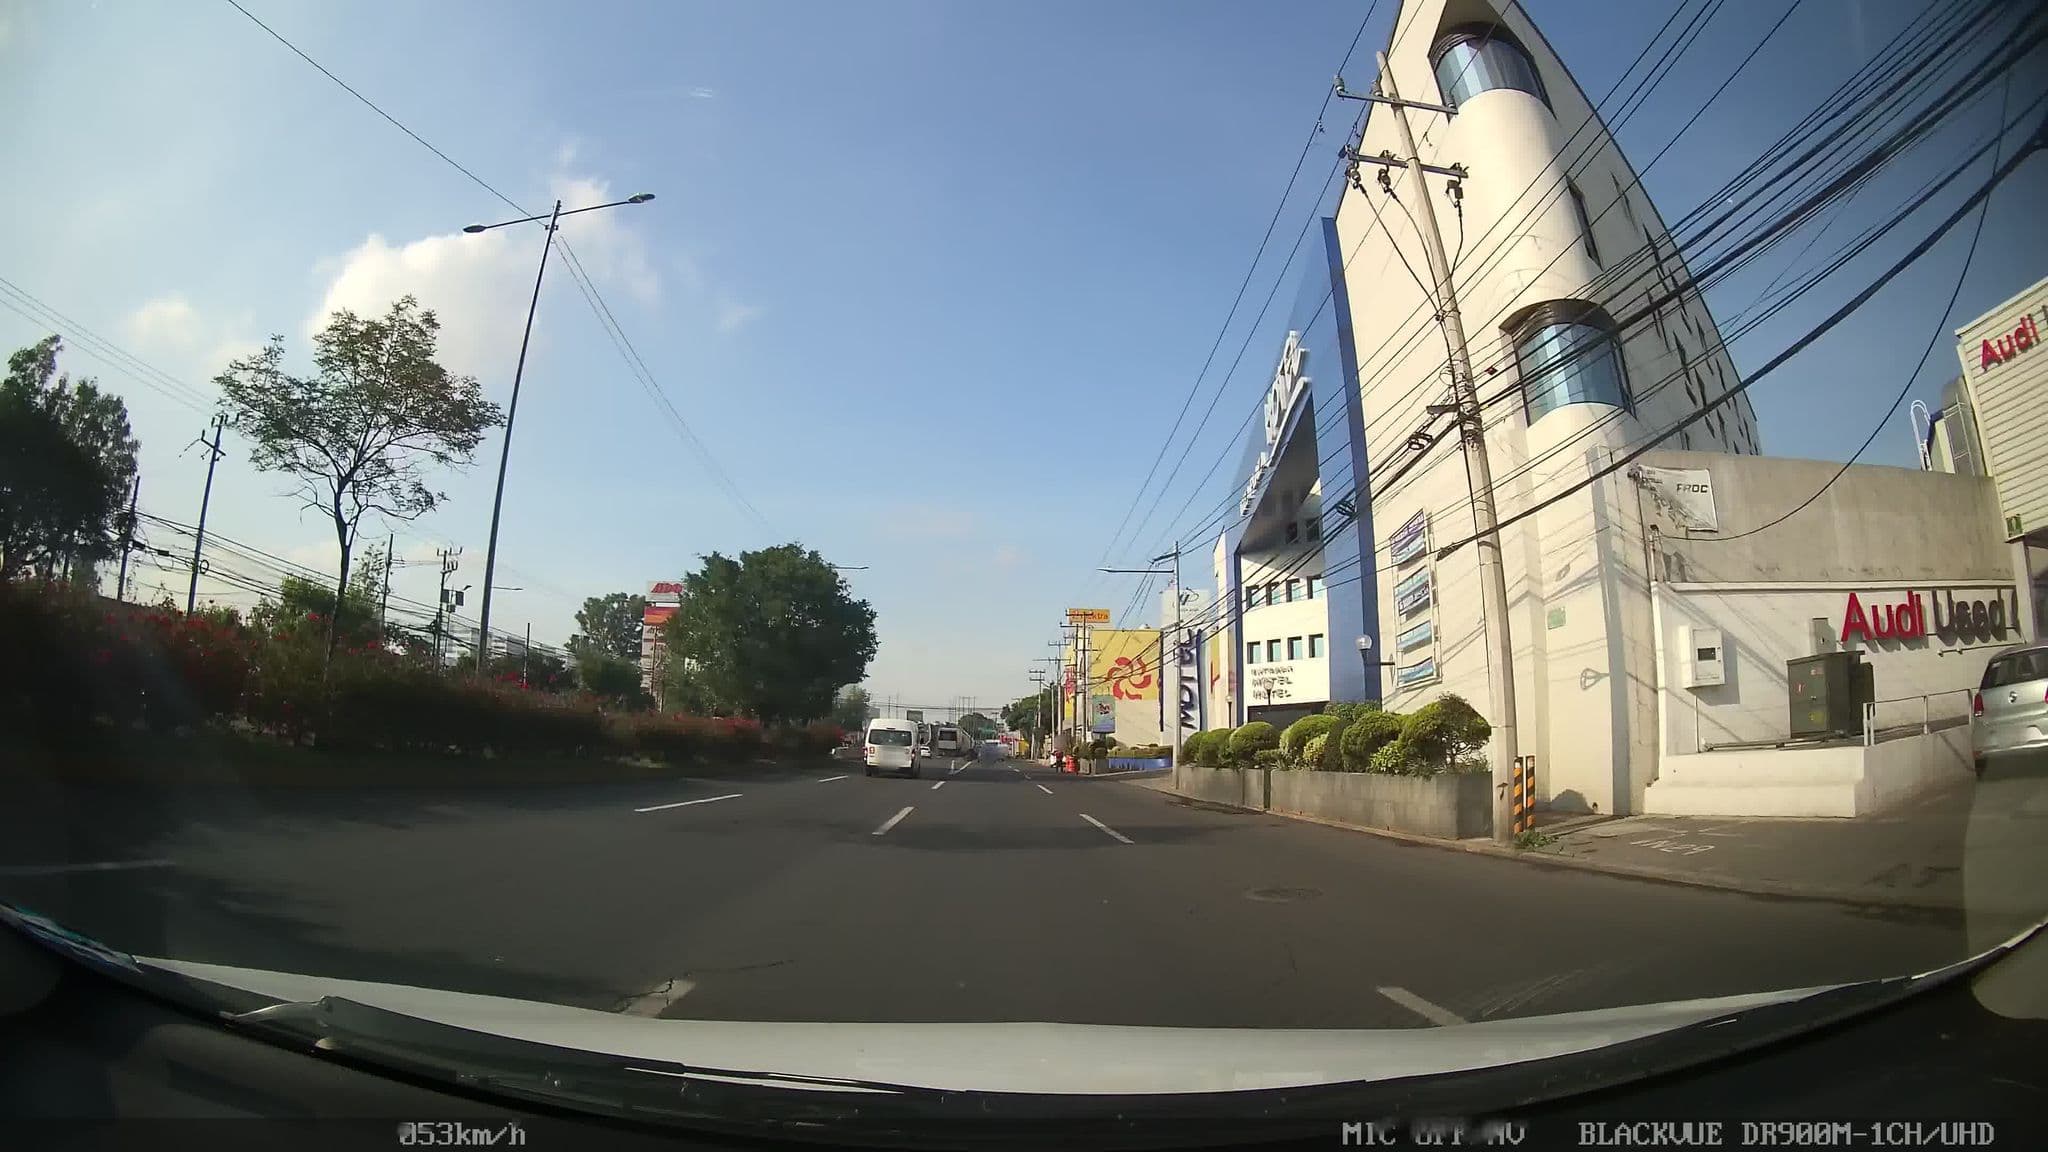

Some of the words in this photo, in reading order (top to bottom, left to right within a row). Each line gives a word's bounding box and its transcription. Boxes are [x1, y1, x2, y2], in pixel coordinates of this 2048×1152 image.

[1980, 313, 2040, 371] Audi
[1840, 589, 1925, 643] Audi
[1931, 588, 2008, 636] Used
